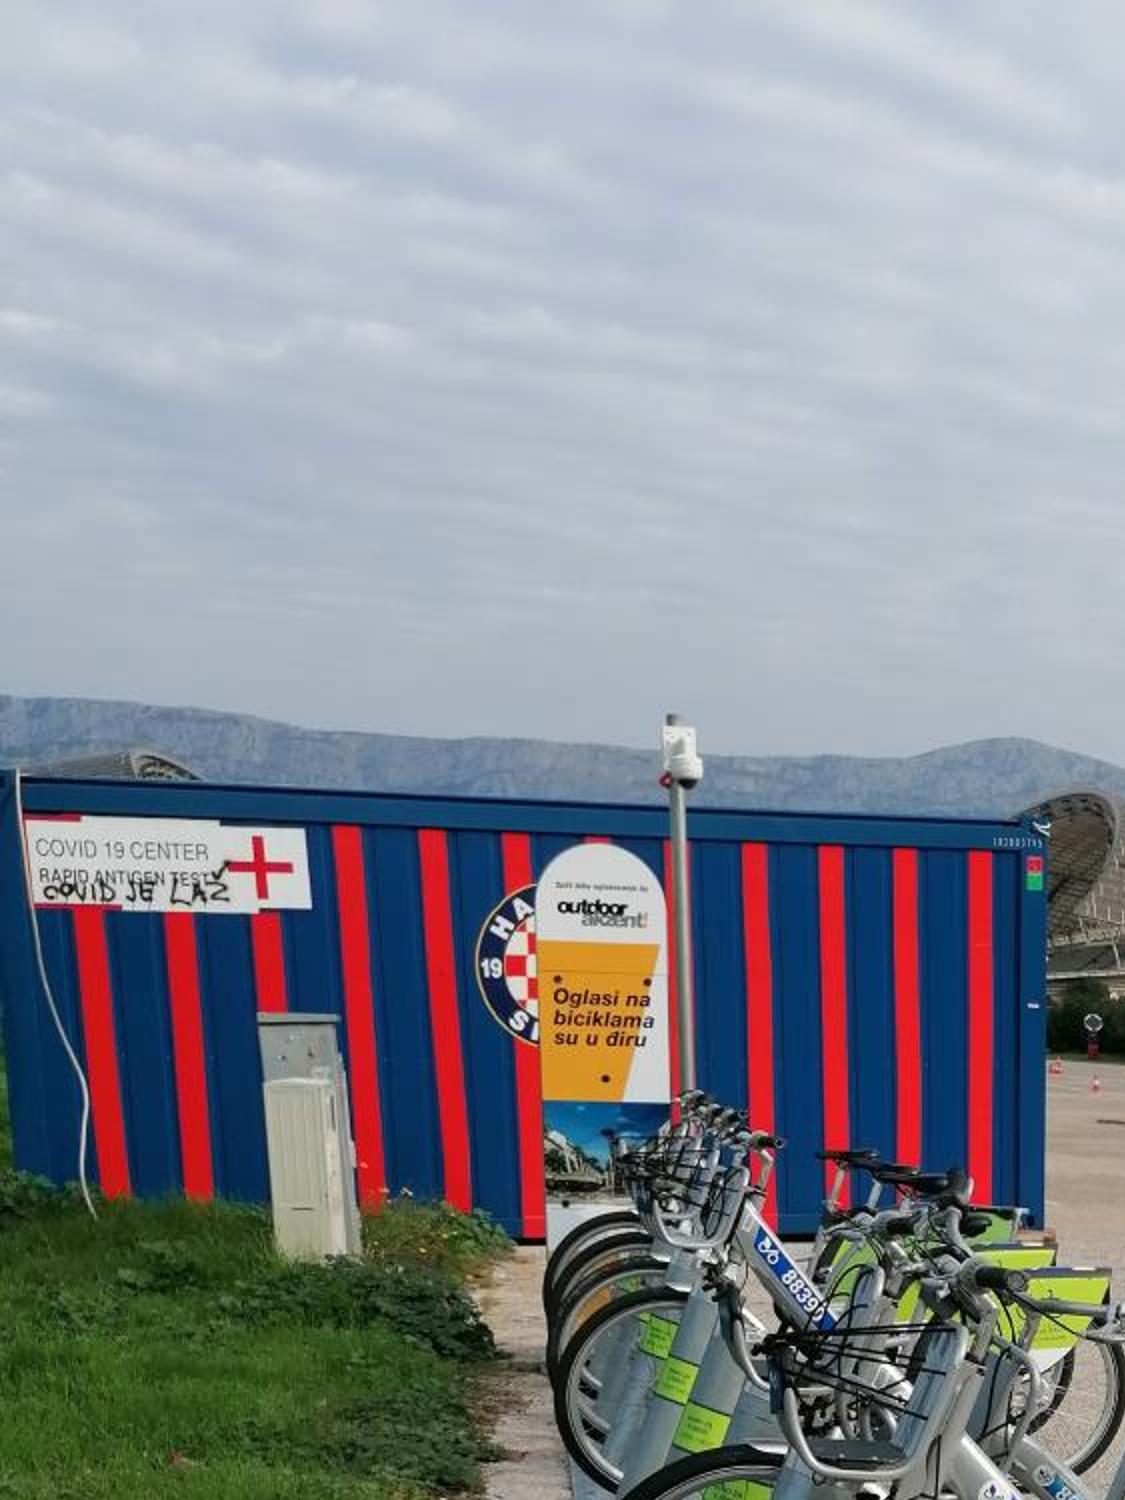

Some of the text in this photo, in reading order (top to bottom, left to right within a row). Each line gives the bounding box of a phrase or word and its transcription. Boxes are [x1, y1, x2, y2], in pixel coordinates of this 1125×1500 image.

[35, 839, 209, 861] COVID 19 CENTER
[39, 867, 213, 887] RAPID ANTIGEN TEST
[43, 881, 116, 902] COVID
[125, 879, 155, 902] JE
[557, 900, 628, 916] outdoor
[553, 988, 651, 1008] Oglasi na
[553, 1010, 655, 1029] biciklama
[554, 1033, 578, 1045] su
[586, 1034, 599, 1045] u
